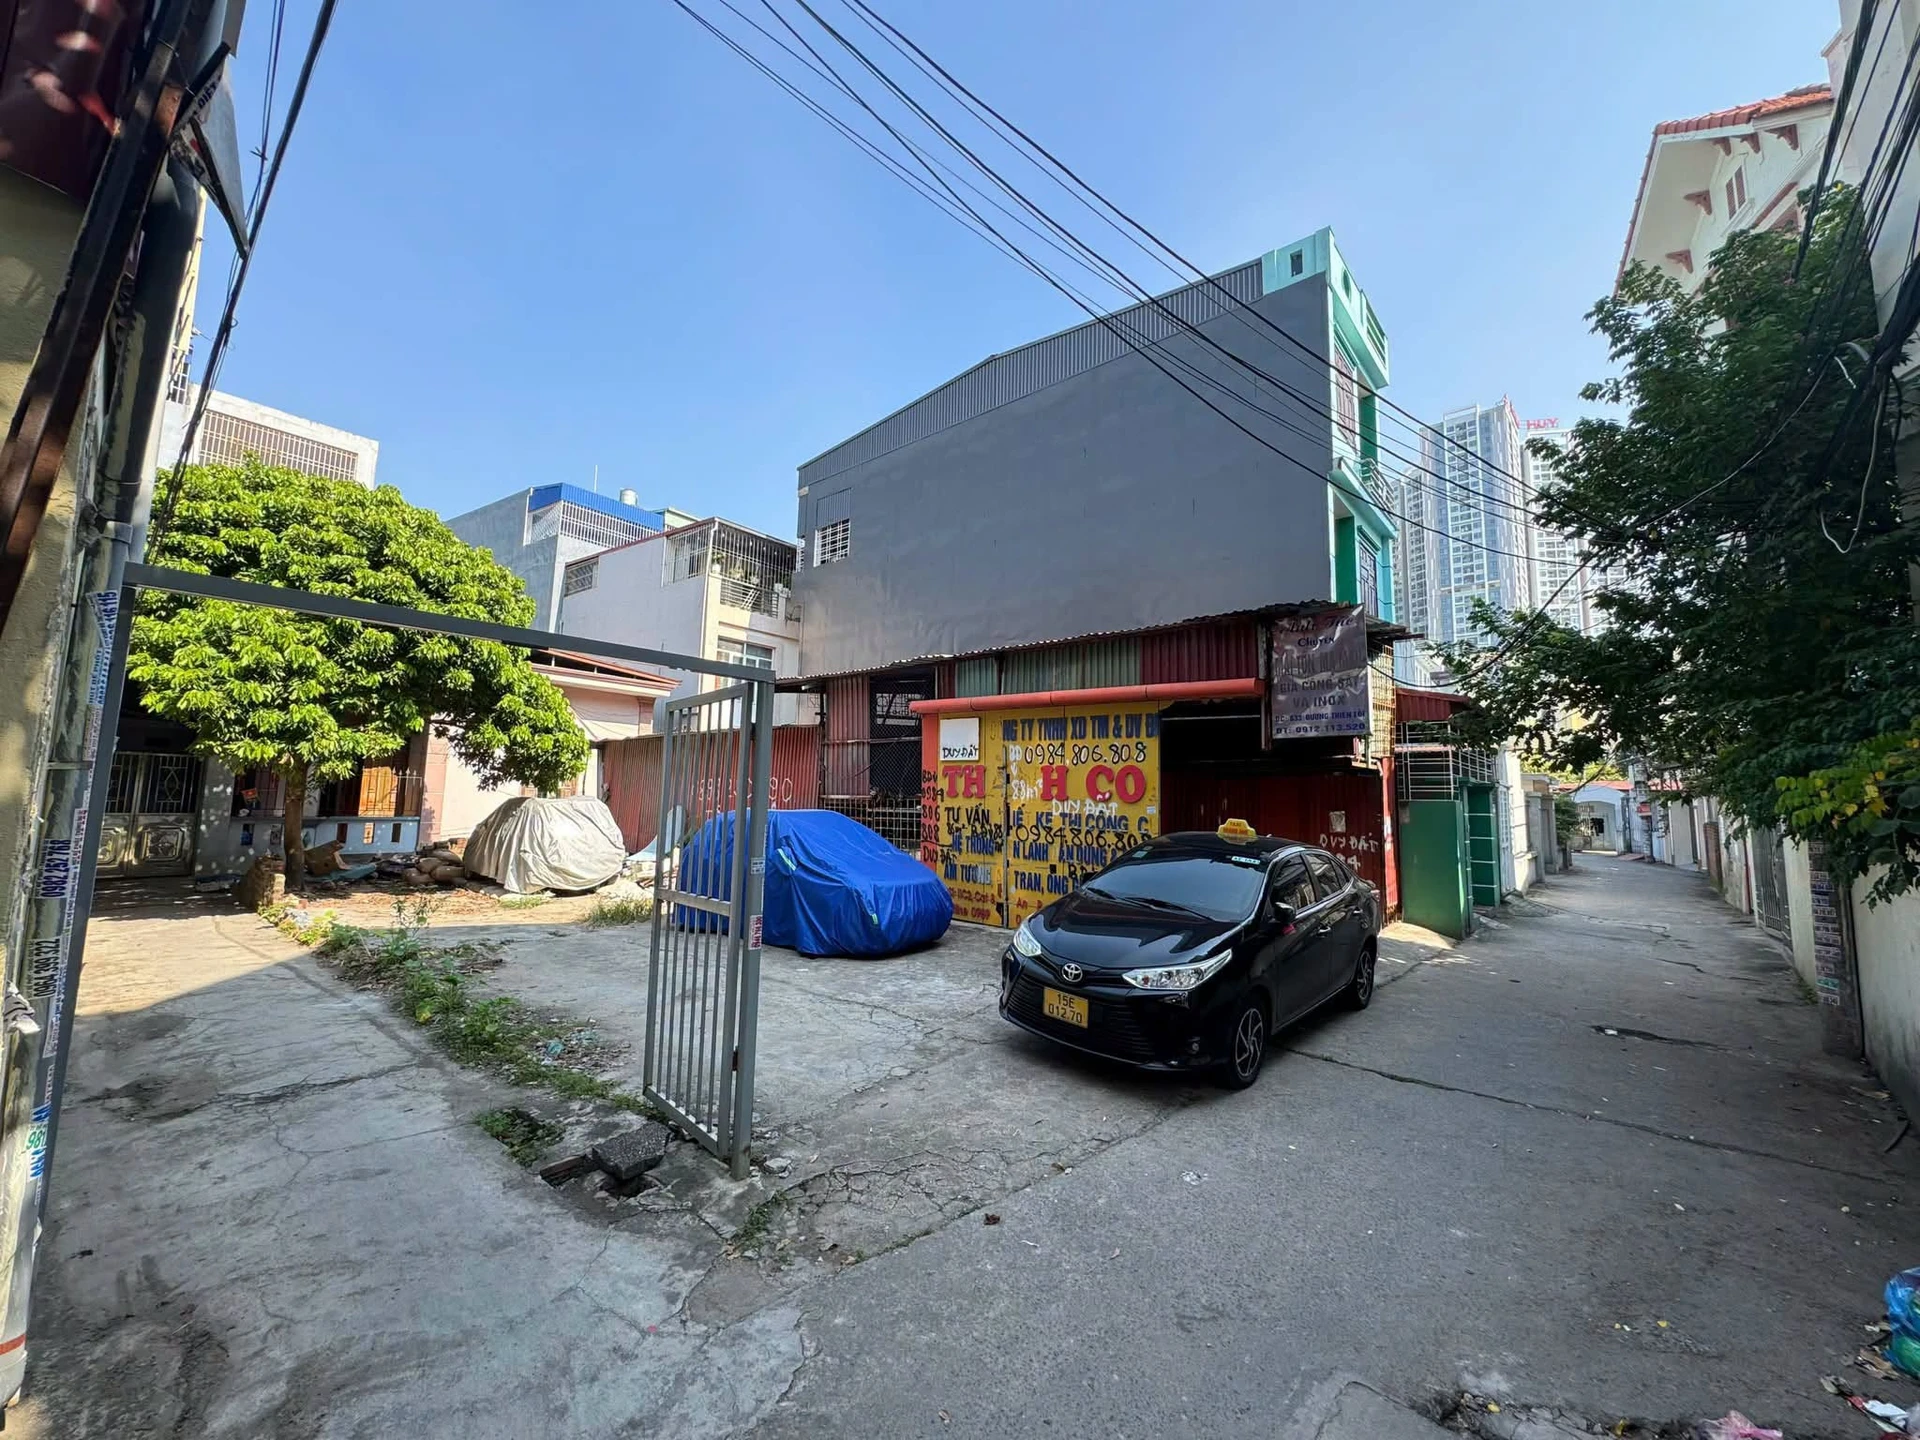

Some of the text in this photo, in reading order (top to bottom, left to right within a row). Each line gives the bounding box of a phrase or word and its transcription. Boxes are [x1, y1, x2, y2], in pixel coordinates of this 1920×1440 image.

[1526, 417, 1559, 430] HUY
[40, 838, 72, 898] 0982 252 768
[34, 938, 60, 957] 322
[34, 956, 59, 973] 399
[34, 973, 56, 997] 0964
[1057, 993, 1076, 1010] 15E
[1048, 1003, 1083, 1024] 012.70
